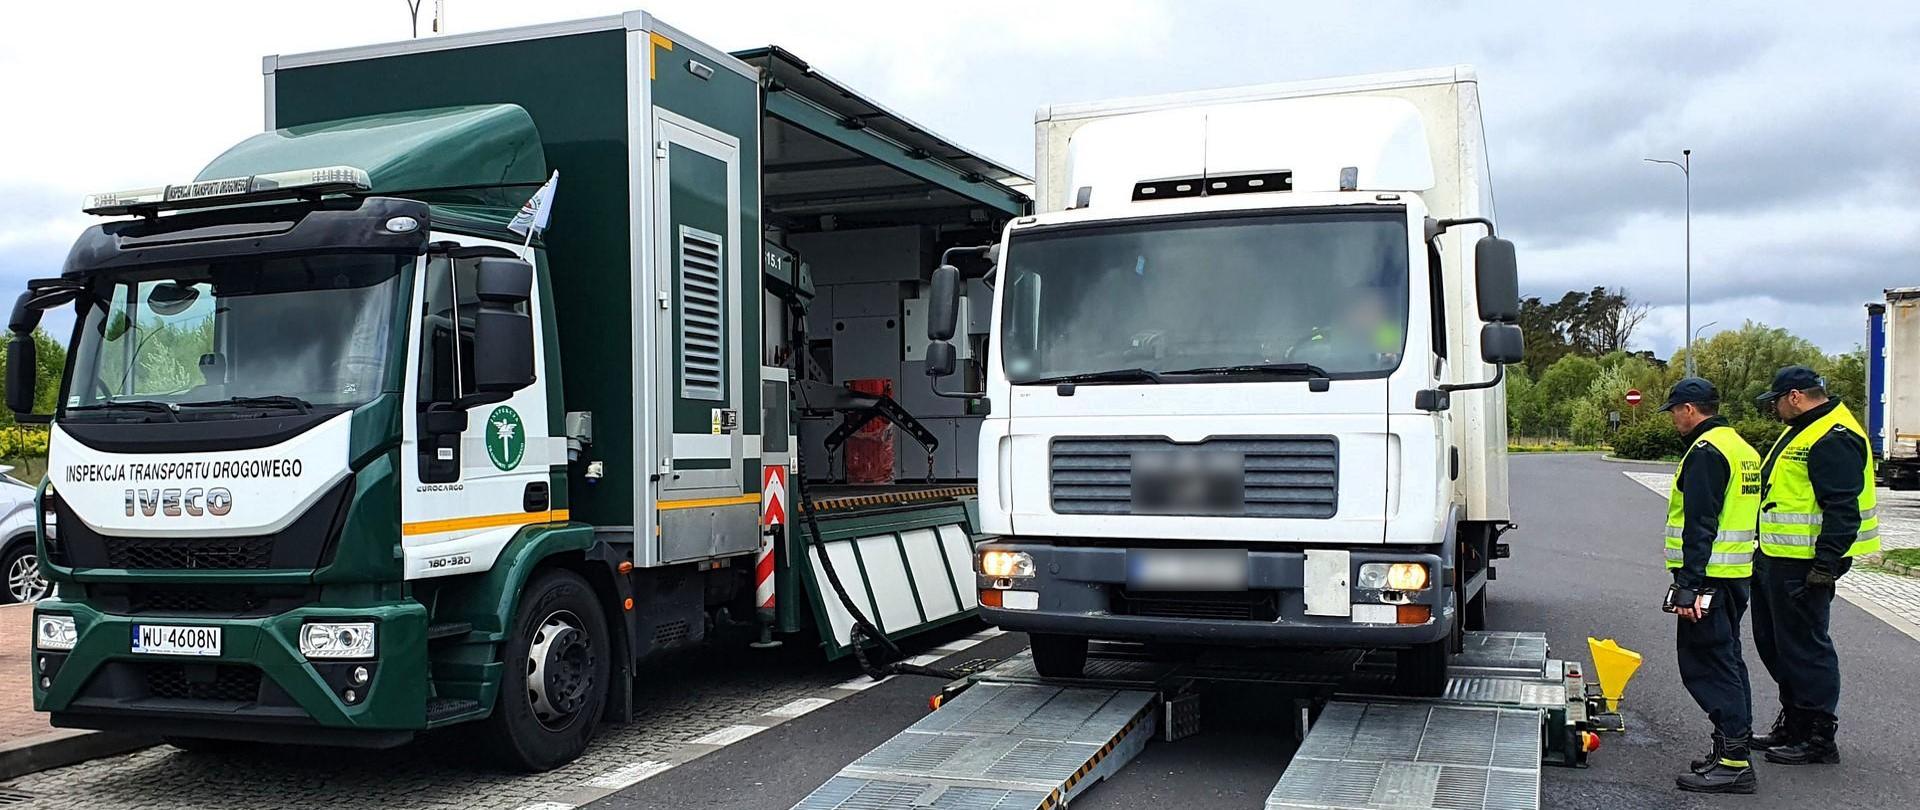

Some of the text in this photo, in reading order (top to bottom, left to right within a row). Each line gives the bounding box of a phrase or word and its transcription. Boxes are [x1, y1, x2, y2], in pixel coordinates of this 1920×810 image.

[66, 458, 302, 482] INSPEKCJA TRANSPORTU DROGOWEGO
[416, 484, 464, 493] EUROCARGO
[125, 486, 232, 517] IVECO
[428, 556, 471, 568] 180-320
[142, 627, 217, 649] WU 4608N
